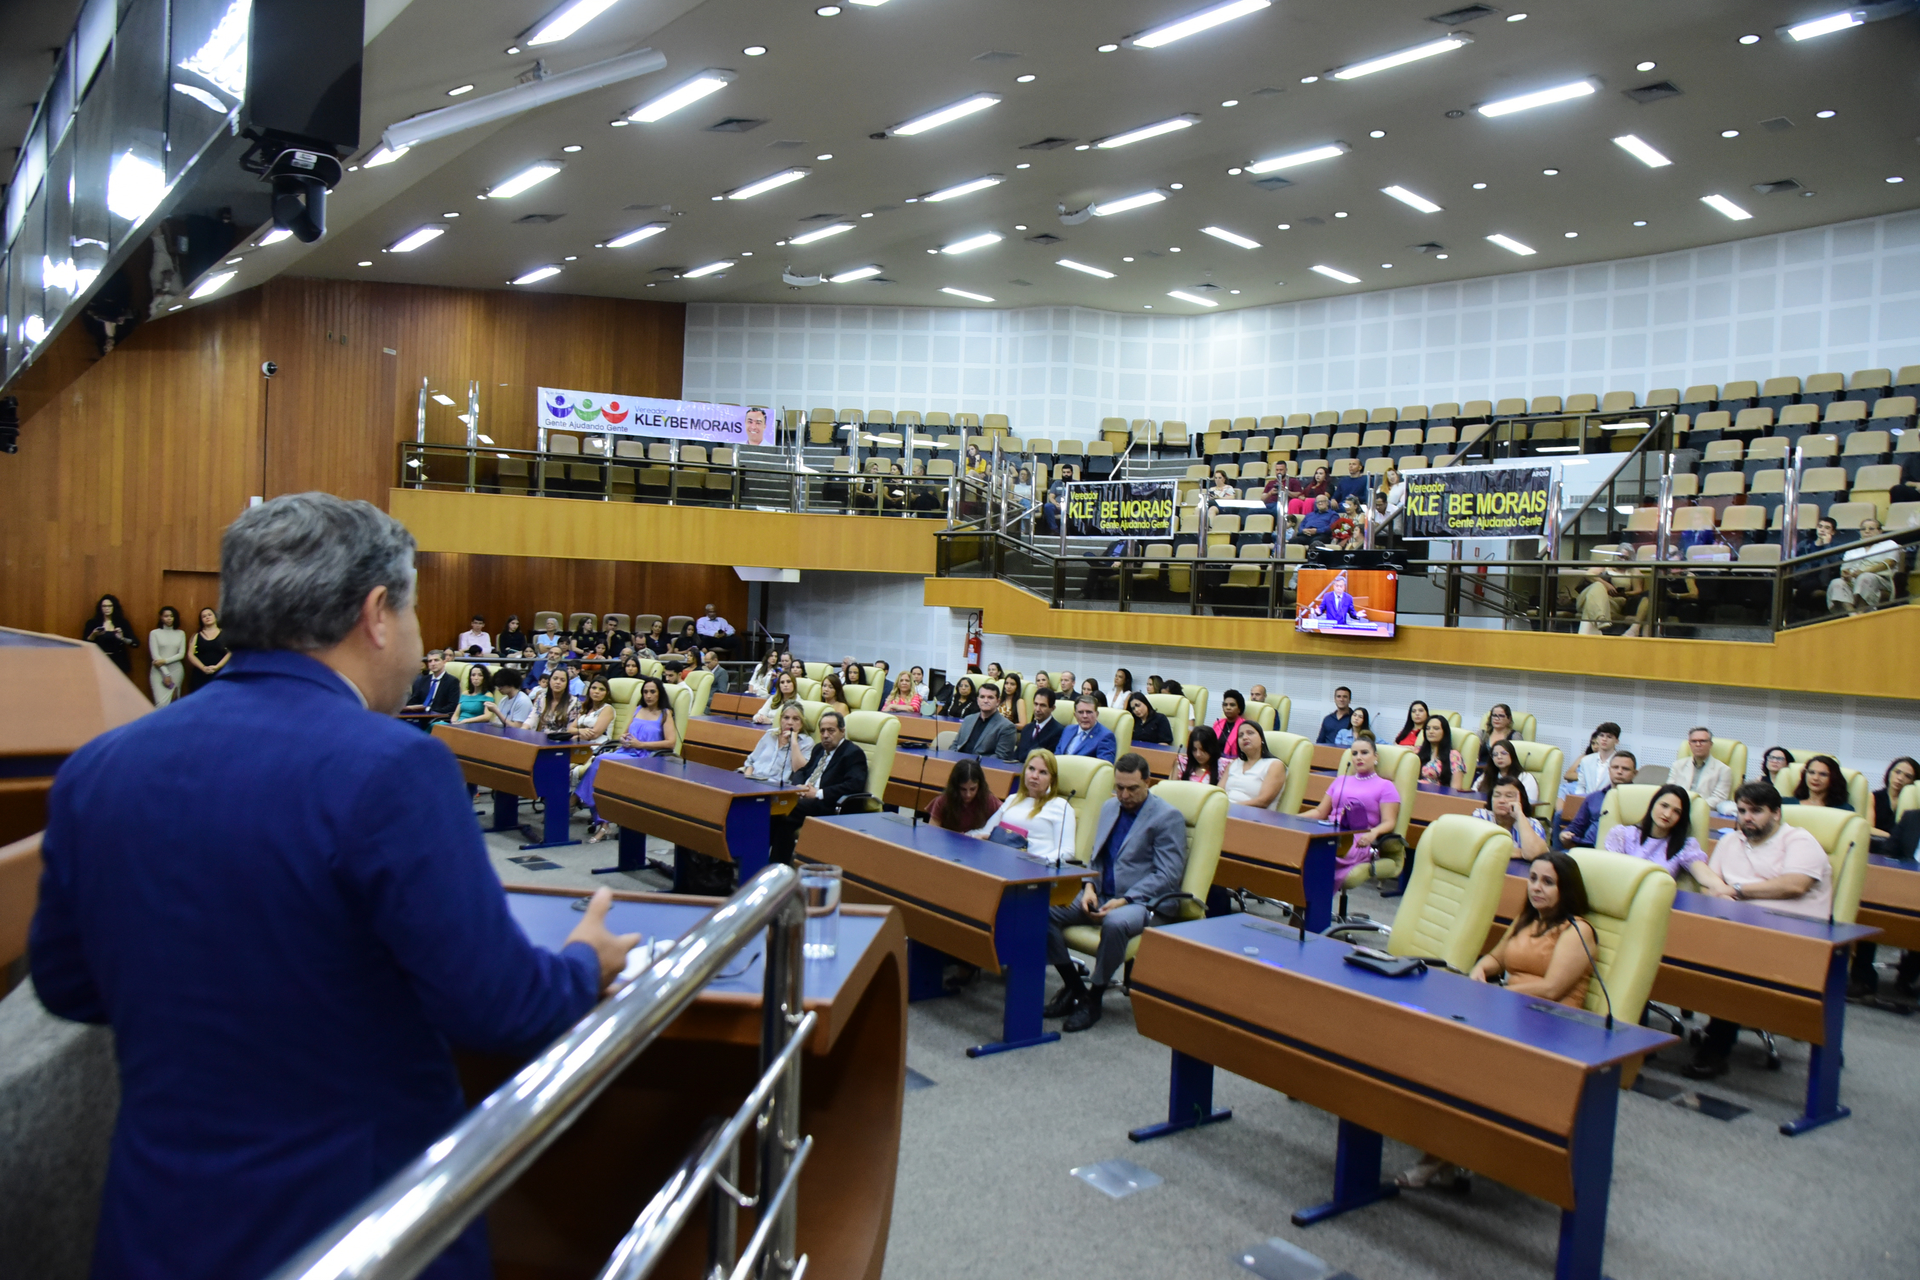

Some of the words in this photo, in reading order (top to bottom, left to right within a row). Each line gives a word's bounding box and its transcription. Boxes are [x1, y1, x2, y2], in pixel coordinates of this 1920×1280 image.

[635, 406, 667, 414] Vereador
[545, 419, 567, 427] Gente
[569, 421, 605, 431] Ajudando
[635, 413, 688, 429] KLEYBE
[690, 418, 743, 434] MORAIS
[1408, 481, 1445, 493] Vereador
[1070, 491, 1098, 500] Vereador
[1121, 499, 1172, 518] MORAIS
[1476, 490, 1547, 515] MORAIS
[1100, 520, 1119, 529] Gente
[1121, 520, 1150, 531] Ajudando
[1151, 519, 1169, 528] Gente
[1448, 517, 1474, 528] Gente
[1476, 516, 1517, 530] Ajudando
[1518, 515, 1543, 527] Gente
